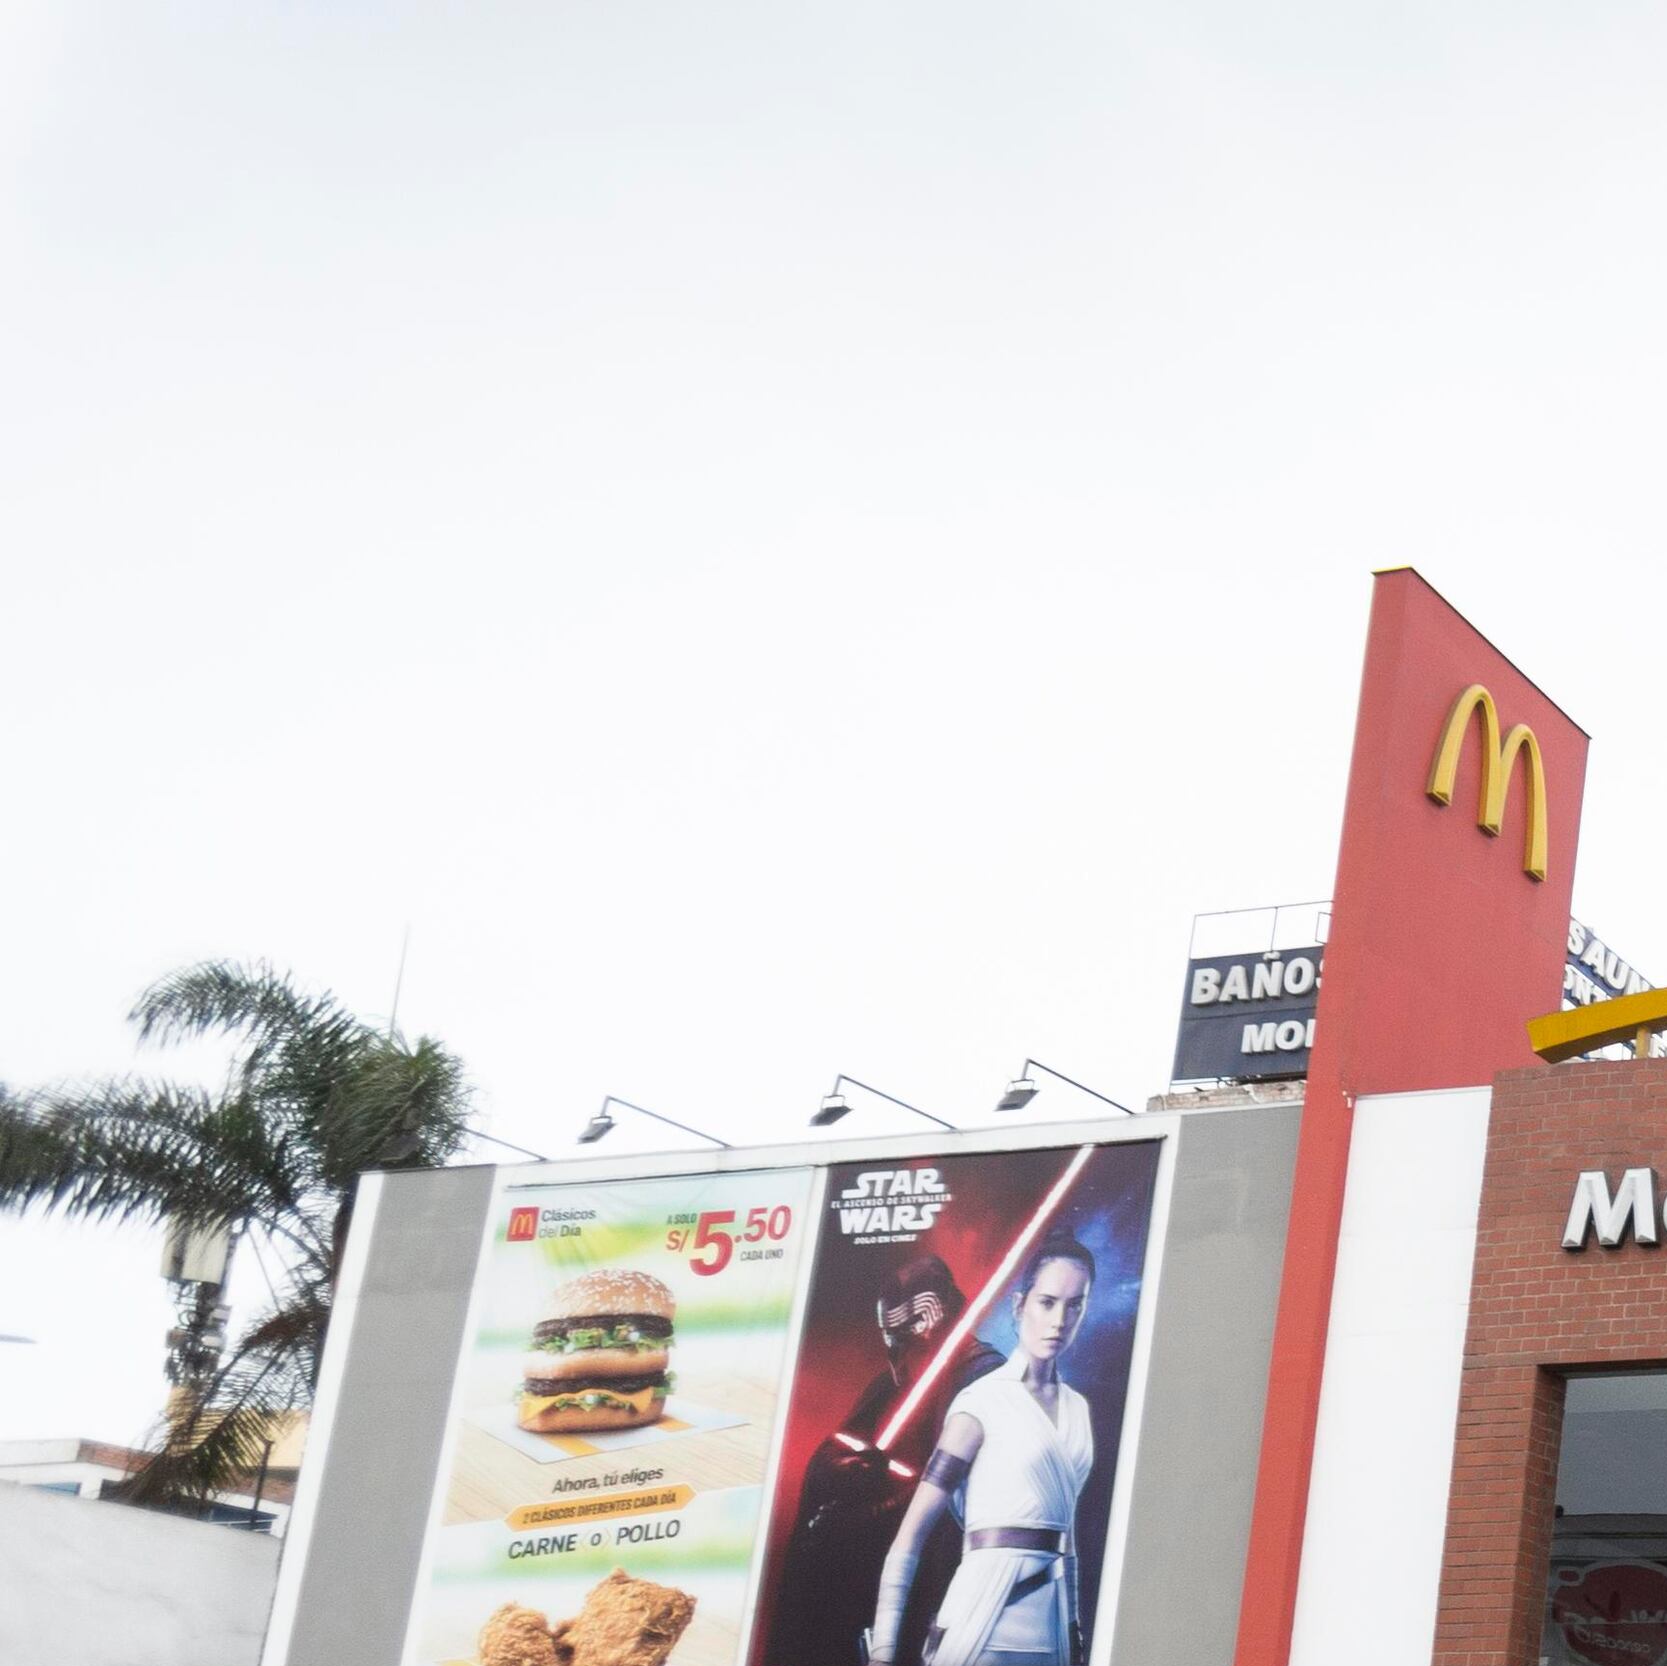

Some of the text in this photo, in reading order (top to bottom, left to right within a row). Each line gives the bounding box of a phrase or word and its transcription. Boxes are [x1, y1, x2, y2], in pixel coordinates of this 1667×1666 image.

[1190, 952, 1325, 1006] BAÑO
[841, 1168, 945, 1199] STAR
[541, 1208, 597, 1222] Clásicos
[673, 1213, 698, 1225] SOLO
[840, 1203, 942, 1234] WARS
[538, 1224, 582, 1238] del Día
[740, 1249, 784, 1262] CADA UNO
[552, 1468, 664, 1494] Ahora, tú eliges
[530, 1505, 577, 1524] CLÁSICOS
[577, 1498, 632, 1518] DIFERENTES
[633, 1494, 658, 1509] CADA
[508, 1533, 578, 1560] CARNE
[616, 1519, 681, 1546] POLLO
